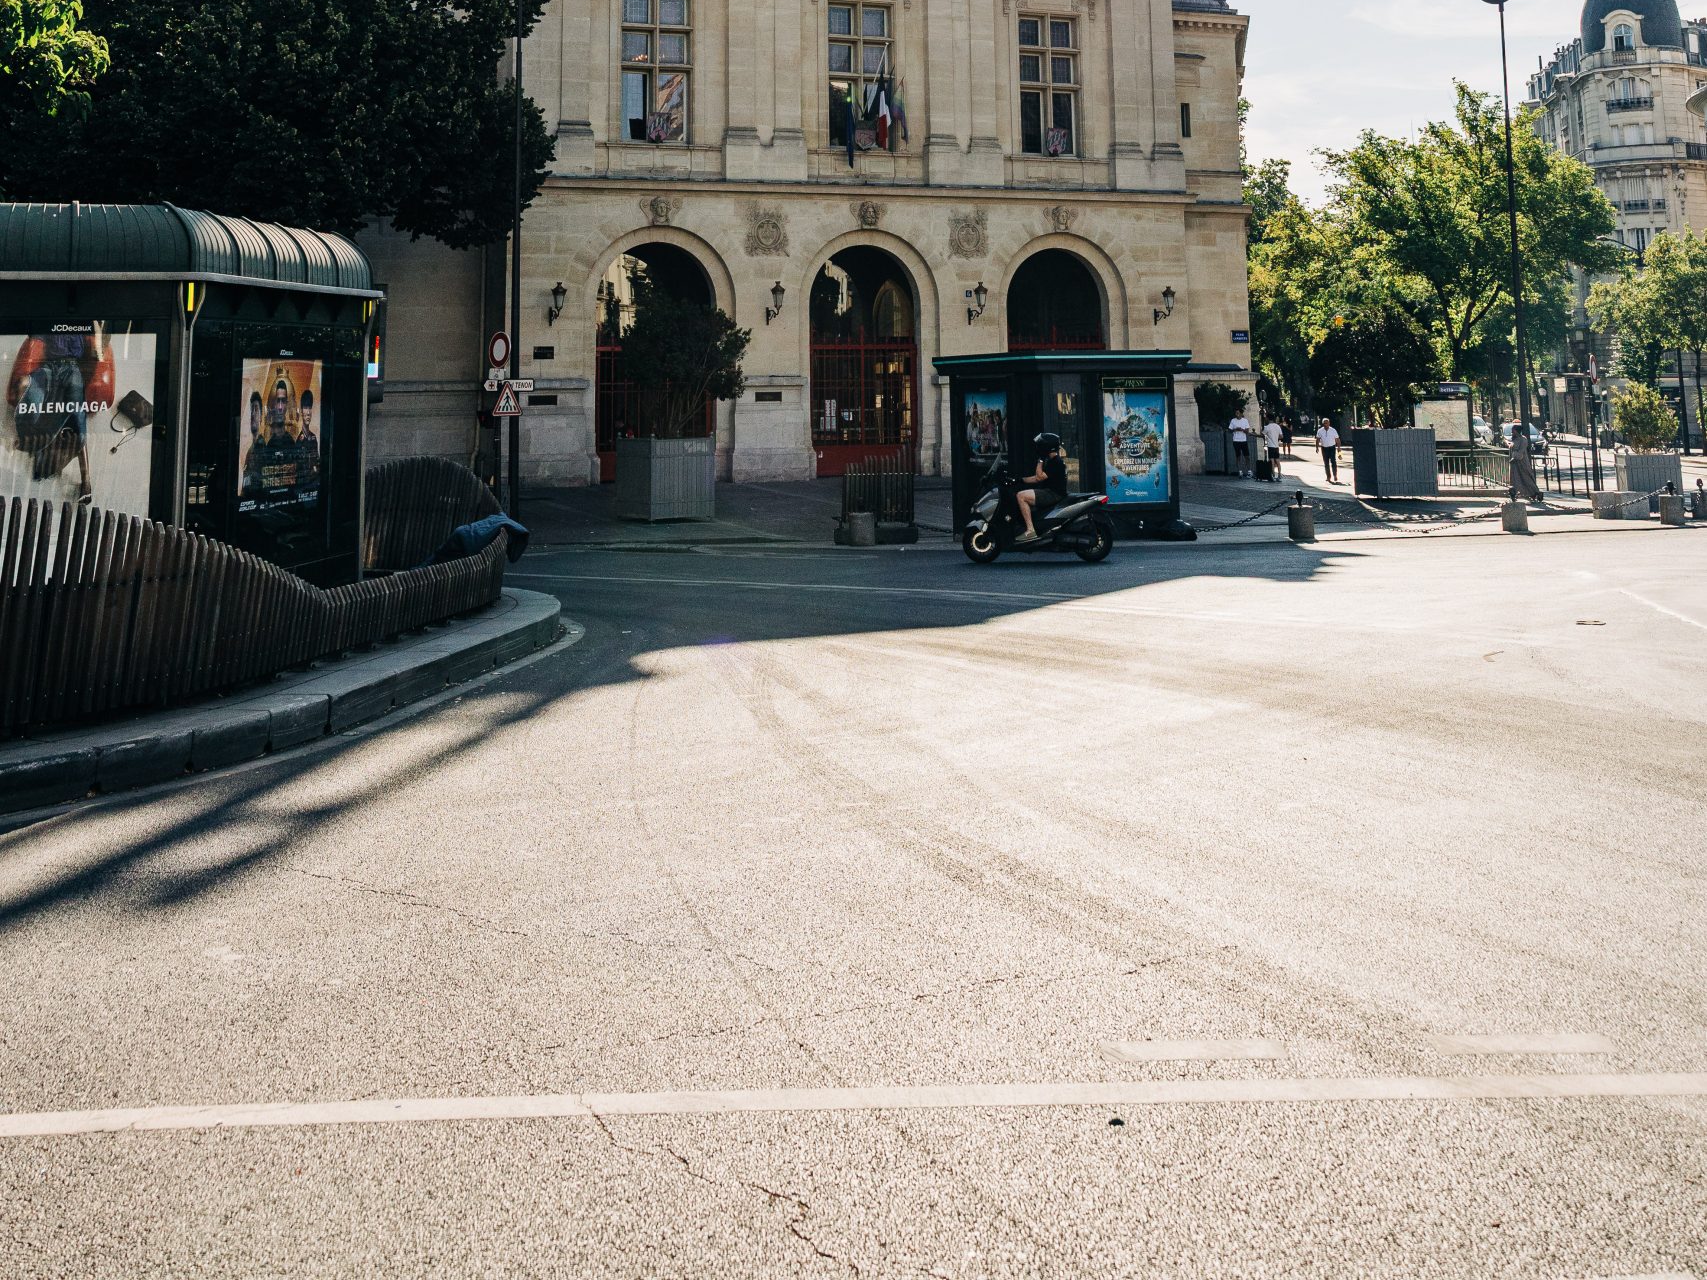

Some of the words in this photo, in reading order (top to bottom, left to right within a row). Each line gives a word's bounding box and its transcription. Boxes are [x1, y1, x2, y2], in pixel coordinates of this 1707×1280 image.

[51, 324, 92, 332] JCDecaux
[515, 381, 532, 389] TENON
[18, 401, 109, 414] BALENCIAGA
